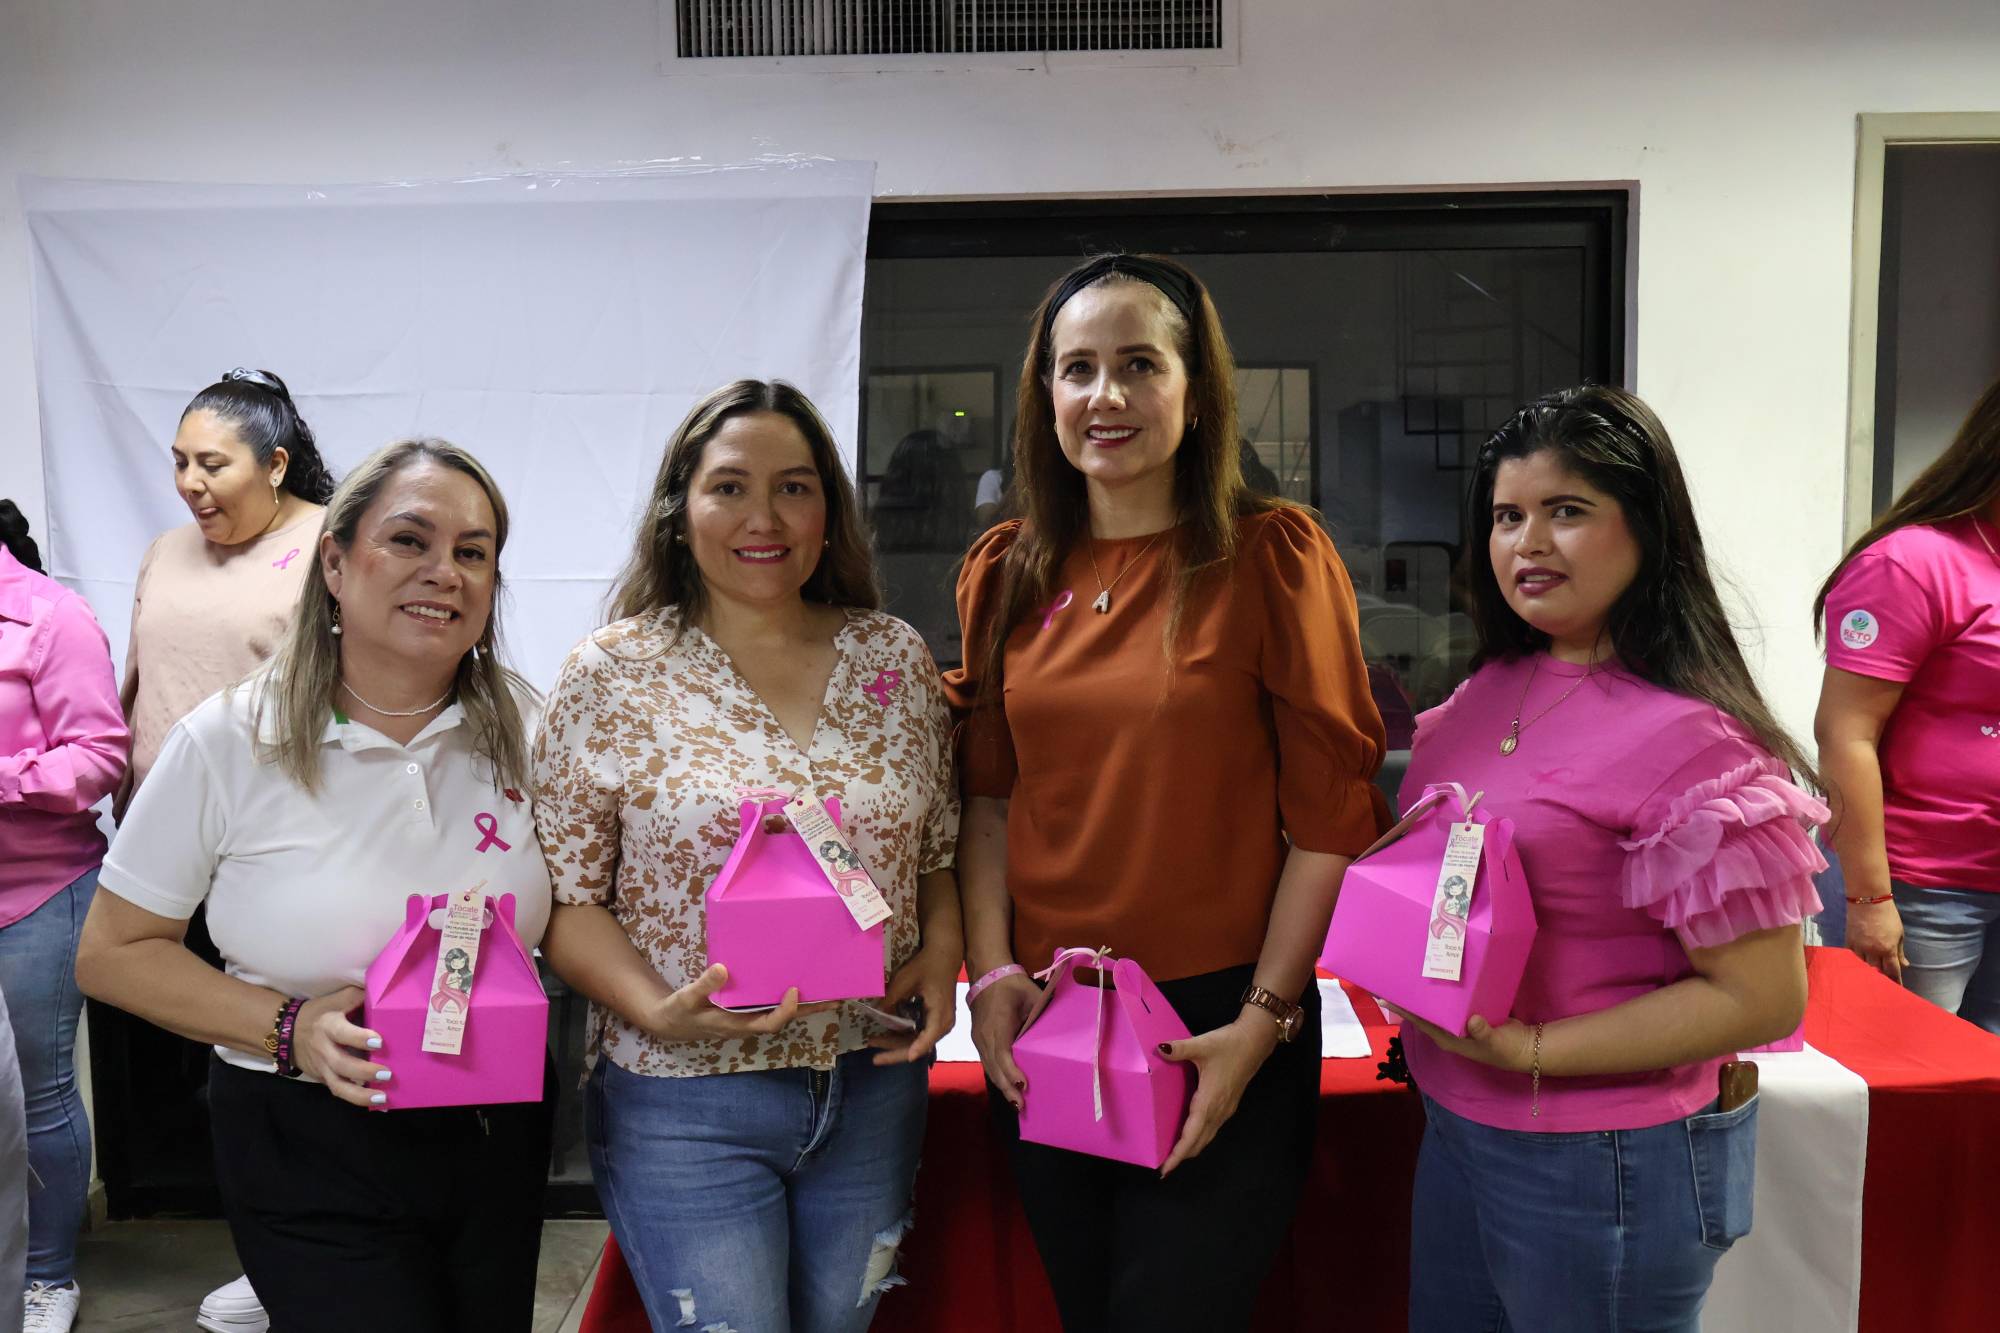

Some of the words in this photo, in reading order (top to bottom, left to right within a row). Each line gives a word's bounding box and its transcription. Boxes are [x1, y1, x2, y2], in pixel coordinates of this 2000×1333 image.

[1091, 590, 1109, 612] A
[1844, 629, 1872, 641] RETO
[280, 1015, 294, 1040] GIVE
